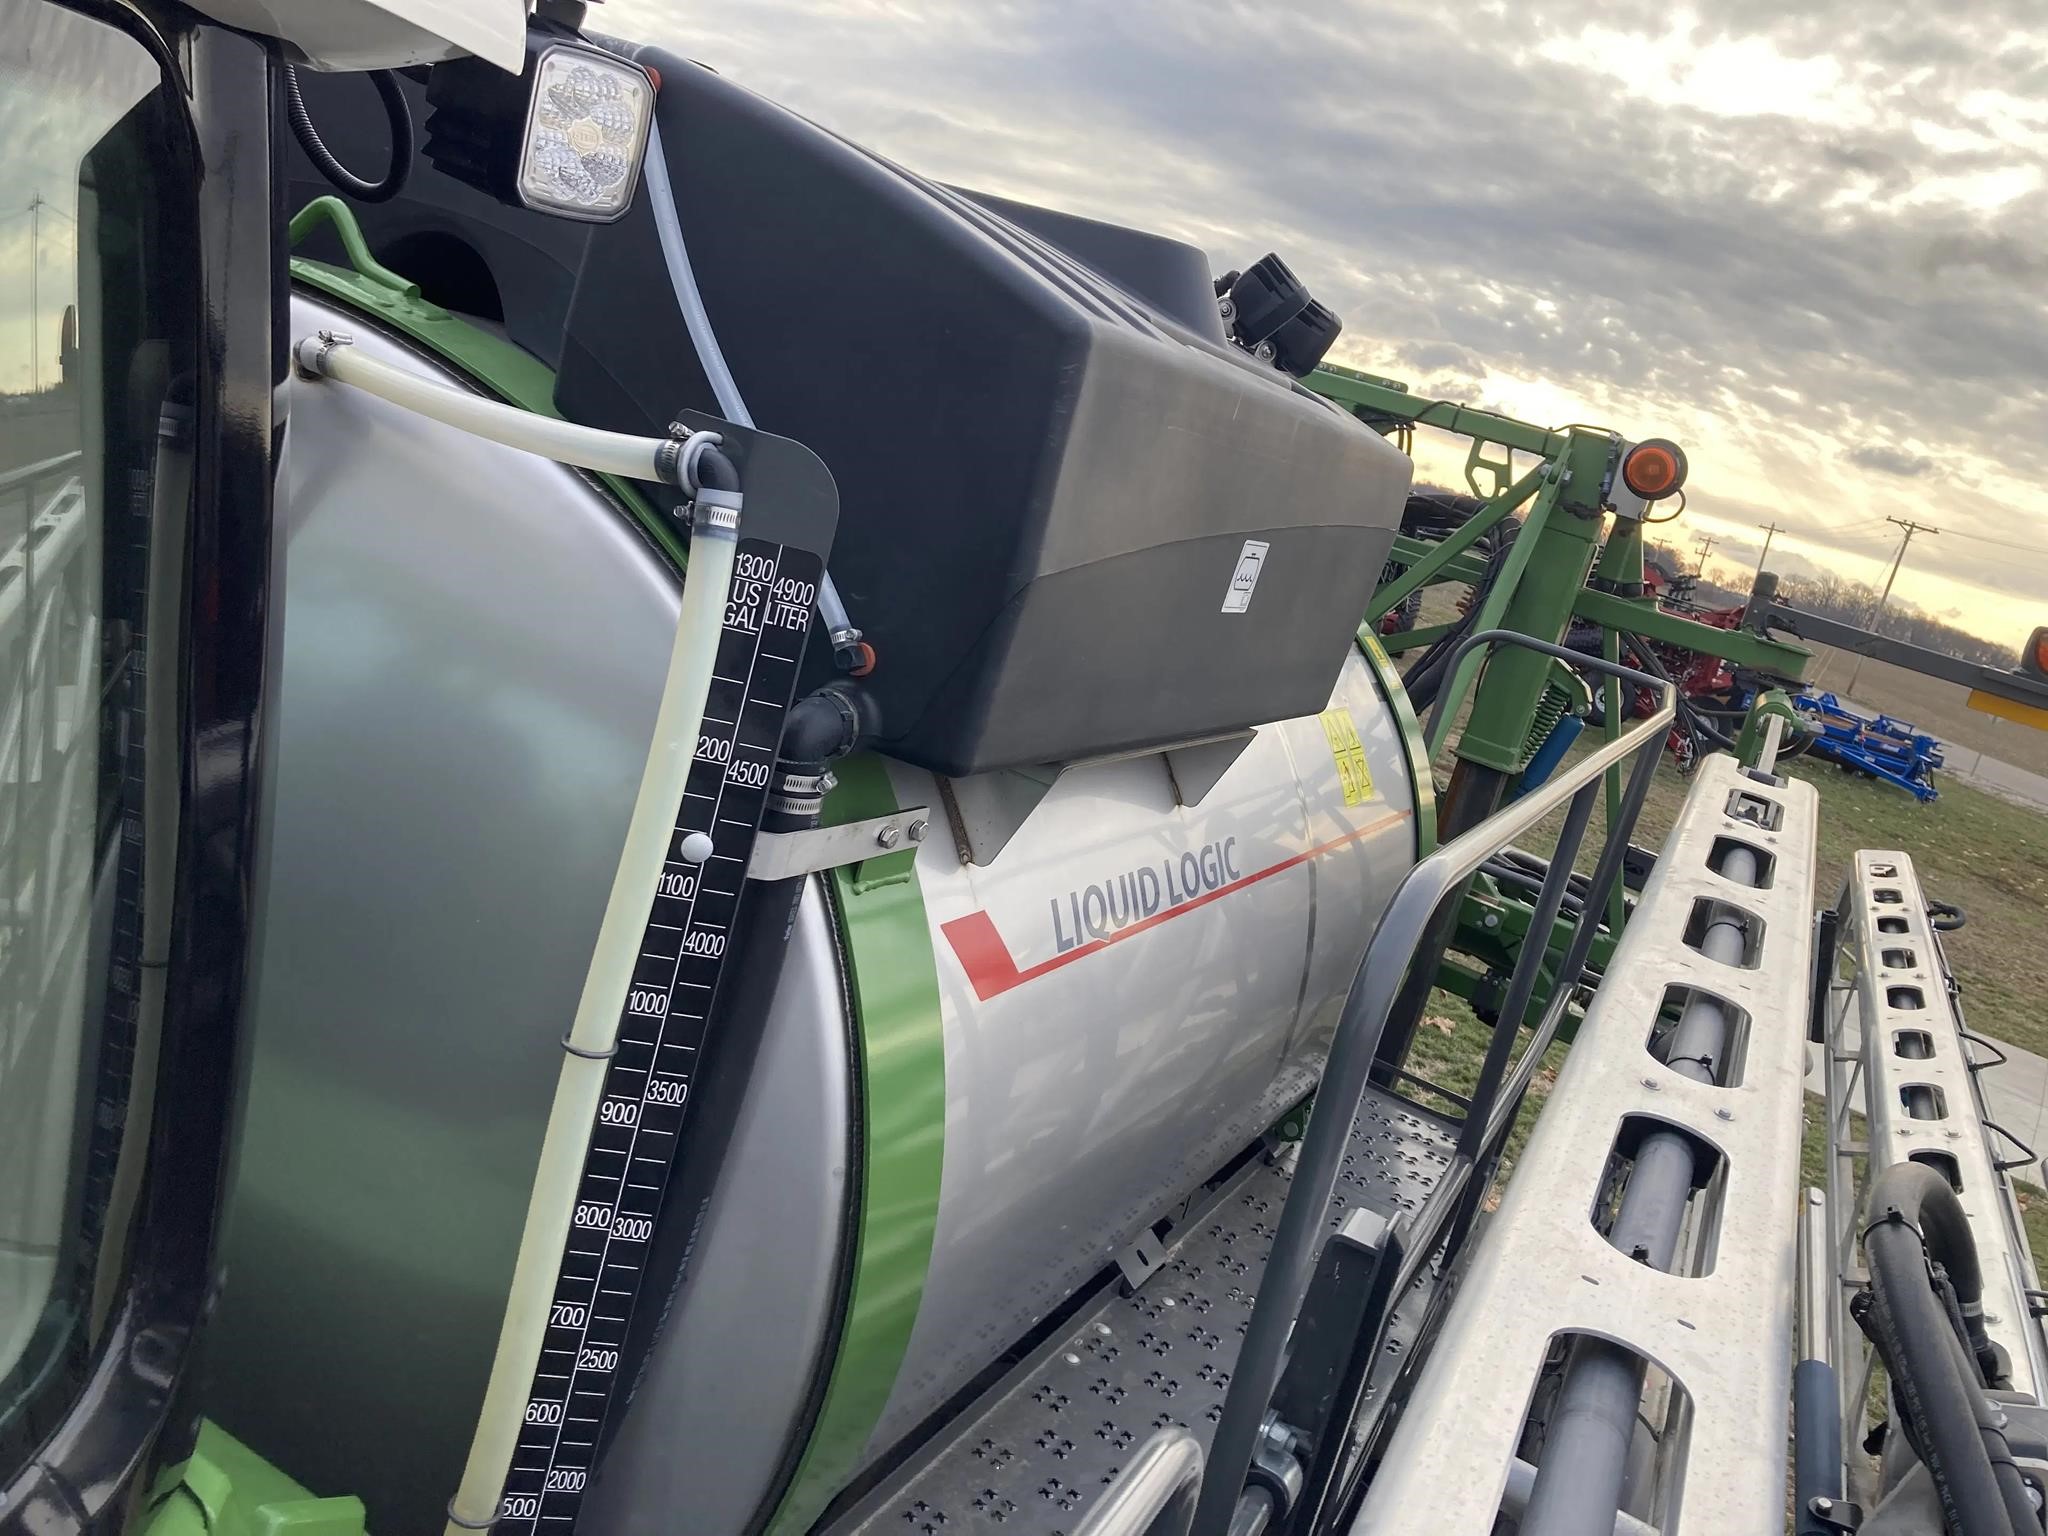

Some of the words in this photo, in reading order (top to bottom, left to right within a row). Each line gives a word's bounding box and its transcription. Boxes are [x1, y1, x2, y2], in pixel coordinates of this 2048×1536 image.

[736, 553, 775, 582] 1300
[733, 580, 762, 606] US
[773, 577, 815, 606] 4900
[723, 602, 759, 631] GAL
[765, 602, 809, 632] LITER
[693, 735, 730, 761] 200
[728, 760, 769, 786] 4500
[659, 872, 694, 898] 1100
[1051, 867, 1160, 953] LIQUID
[1164, 837, 1240, 904] LOGIC
[685, 931, 725, 956] 4000
[629, 990, 667, 1015] 1000
[647, 1080, 688, 1104] 3500
[600, 1101, 637, 1124] 900
[574, 1205, 611, 1227] 800
[613, 1217, 652, 1240] 3000
[550, 1305, 585, 1327] 700
[579, 1349, 619, 1370] 2500
[525, 1403, 561, 1423] 600
[547, 1470, 586, 1490] 2000
[503, 1498, 537, 1517] 500
